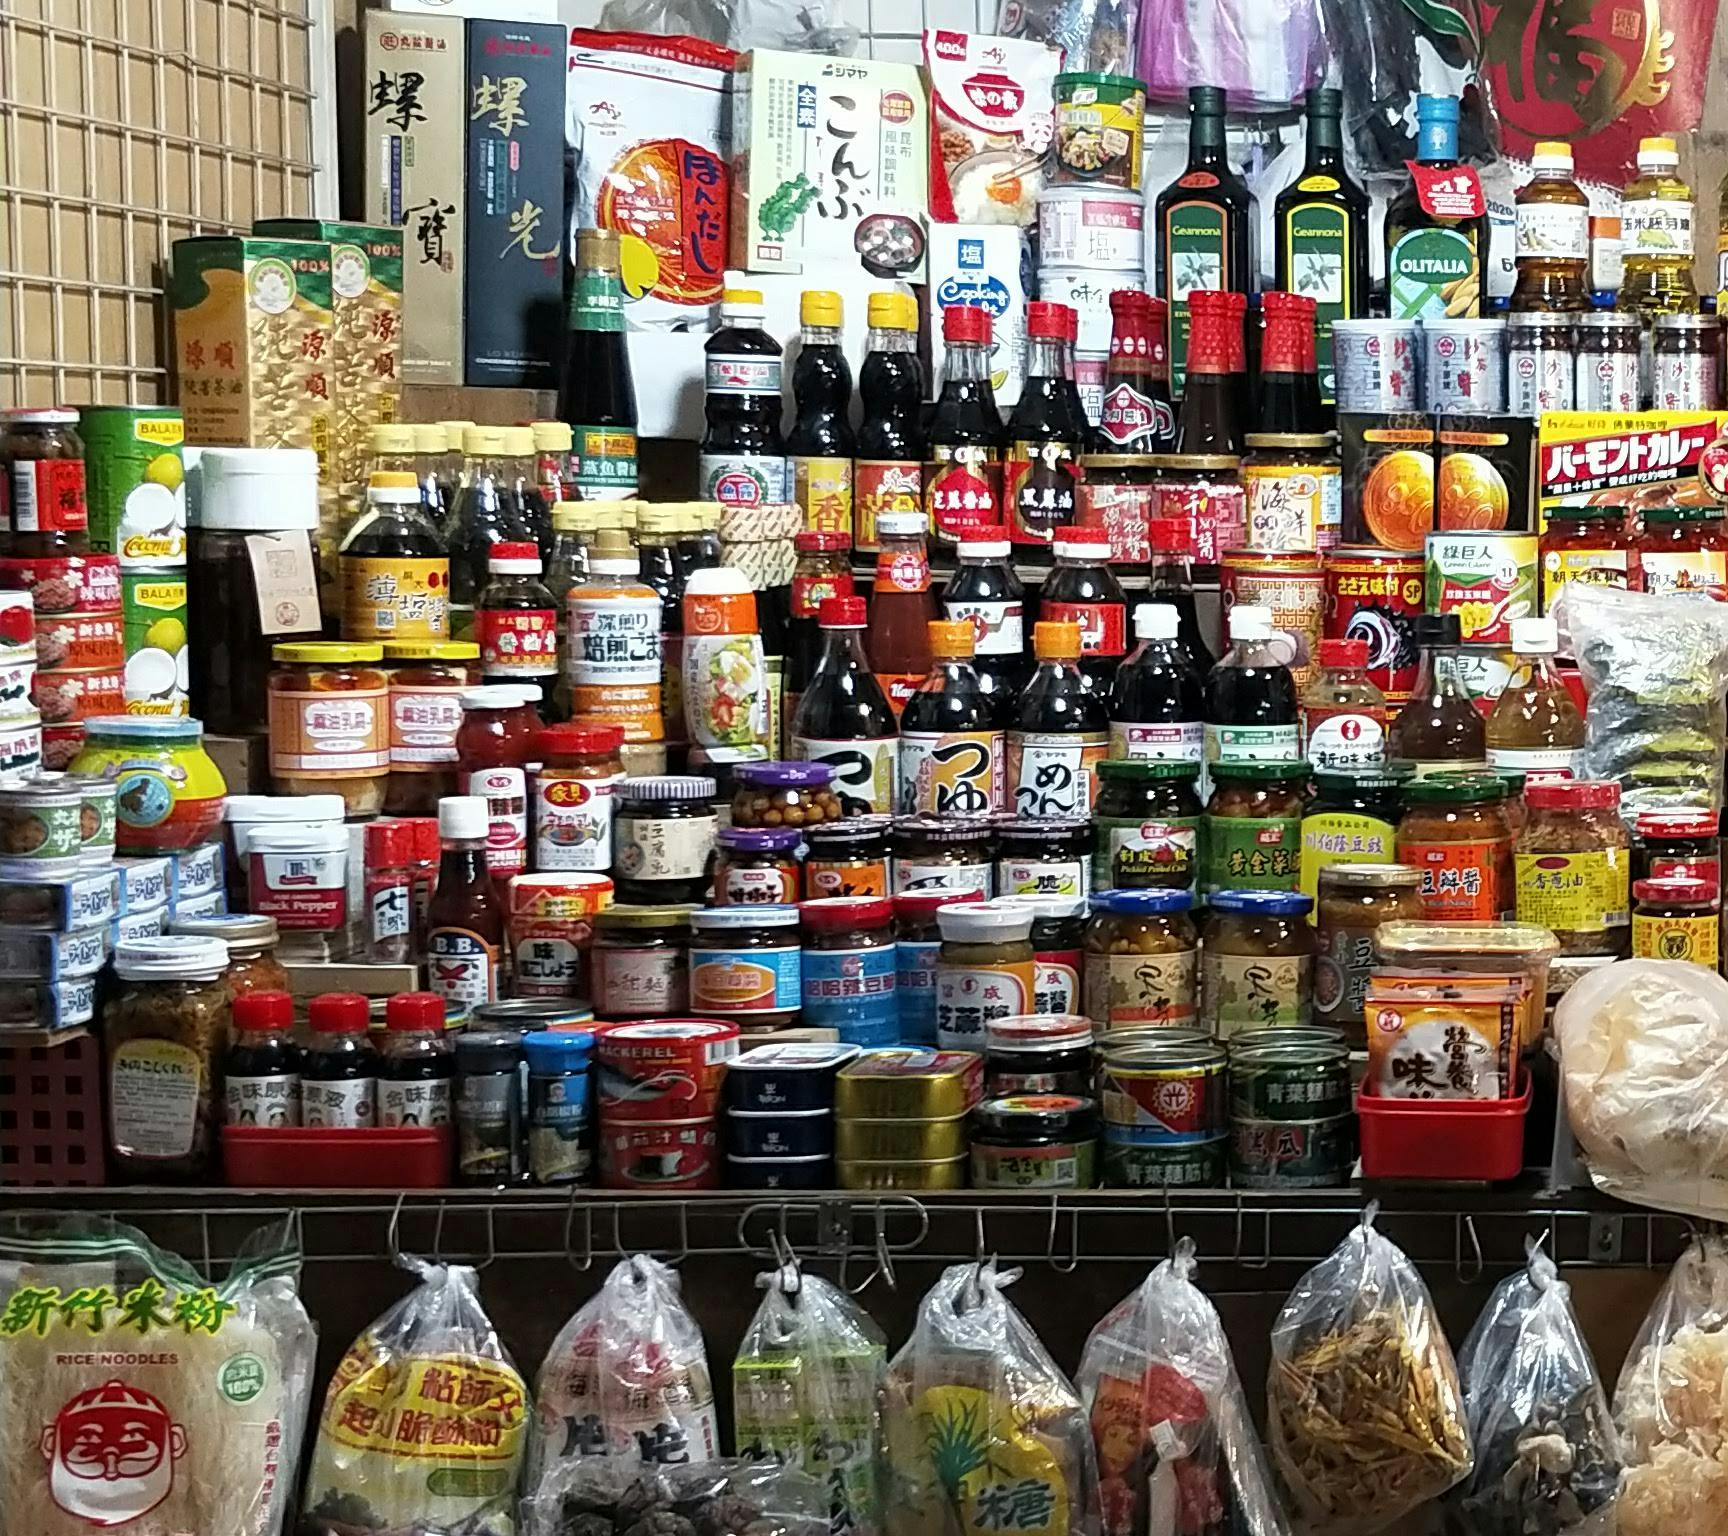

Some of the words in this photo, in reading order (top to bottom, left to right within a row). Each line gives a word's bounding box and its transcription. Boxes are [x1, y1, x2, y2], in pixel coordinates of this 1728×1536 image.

[835, 64, 869, 80] シマヤ
[797, 86, 817, 128] 全素
[818, 94, 872, 221] こんぶ
[1399, 258, 1469, 275] OLITALIA
[1546, 430, 1705, 482] バーモントカレー
[1442, 545, 1493, 560] 綠巨人
[1405, 582, 1421, 599] SP
[583, 632, 661, 663] 焙煎ごま
[931, 741, 994, 815] つゆ
[2, 1281, 236, 1338] 新竹米粉
[56, 1352, 98, 1366] RICE
[100, 1351, 179, 1366] NOODLES
[974, 1483, 1057, 1528] 糖
